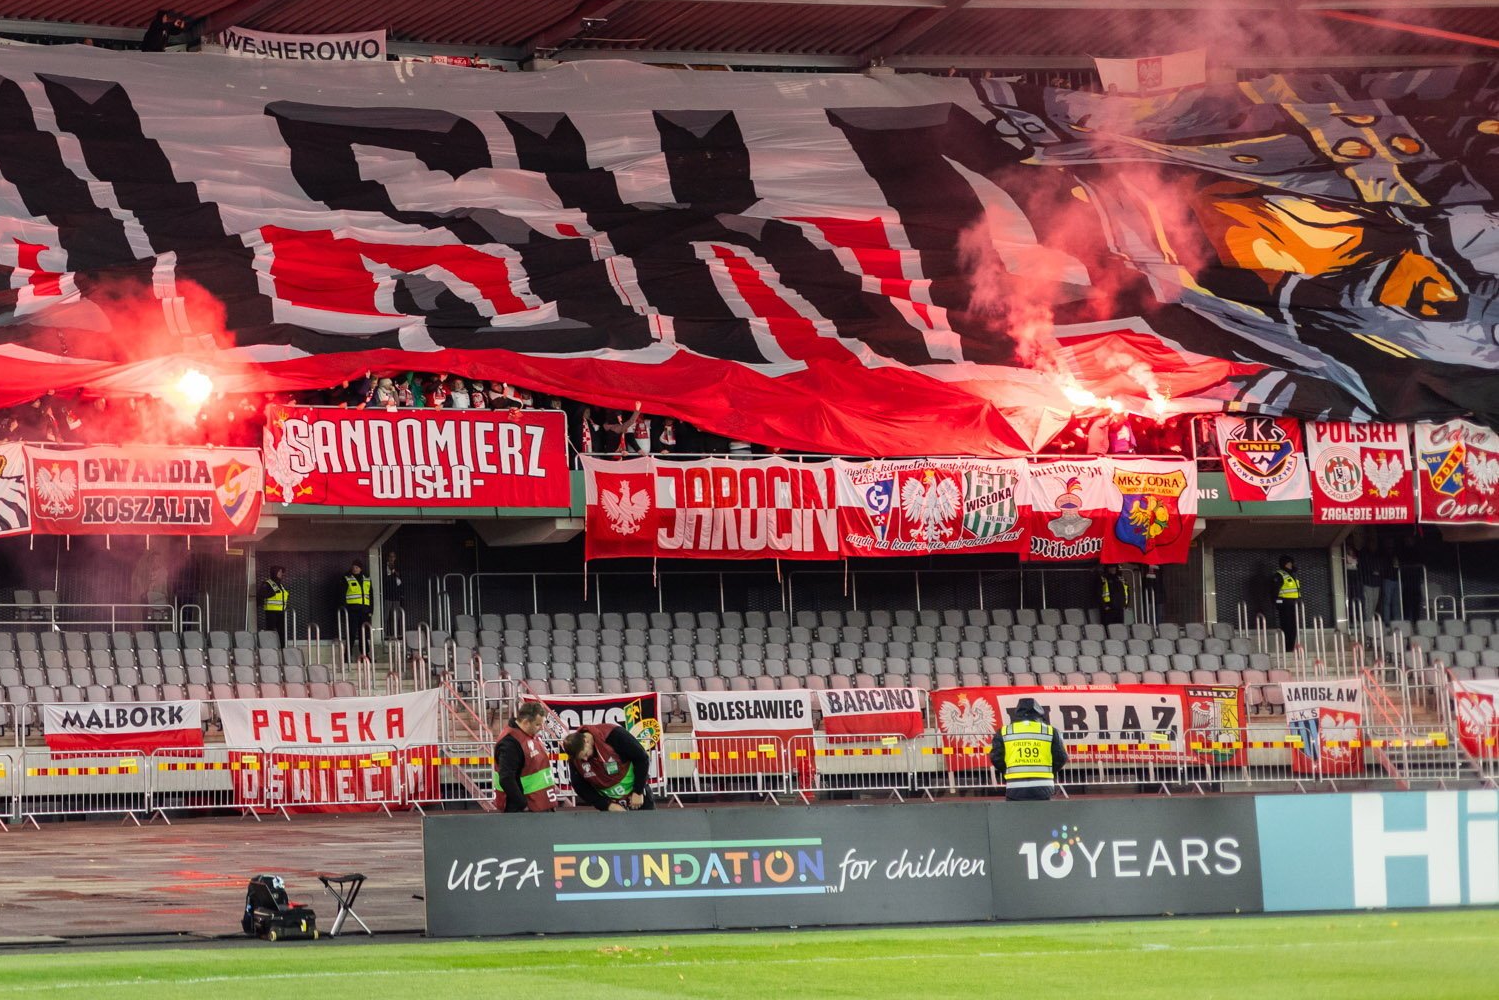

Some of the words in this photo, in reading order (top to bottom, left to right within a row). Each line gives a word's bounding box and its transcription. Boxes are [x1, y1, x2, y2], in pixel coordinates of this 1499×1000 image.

[223, 31, 380, 61] WEJHEROWO
[1315, 423, 1398, 444] POLSKA
[284, 417, 547, 478] SANDOMIERZ
[83, 458, 213, 485] GWARDIA
[855, 472, 893, 485] ZABRZE
[82, 497, 213, 525] KOSZALIN
[656, 466, 839, 552] JAROCIN
[966, 486, 1012, 513] WISŁOKA
[1375, 507, 1408, 520] LUBIN
[827, 688, 916, 713] BARCINO
[1286, 685, 1358, 703] JAROSŁAW
[61, 705, 183, 729] MALBORK
[696, 698, 804, 723] BOLESŁAWIEC
[252, 707, 405, 745] POLSKA
[1017, 747, 1040, 758] 199
[447, 857, 545, 892] UEFA
[554, 849, 826, 889] FOUNDATION
[838, 847, 878, 893] for
[885, 846, 987, 880] children
[1077, 837, 1242, 880] YEARS
